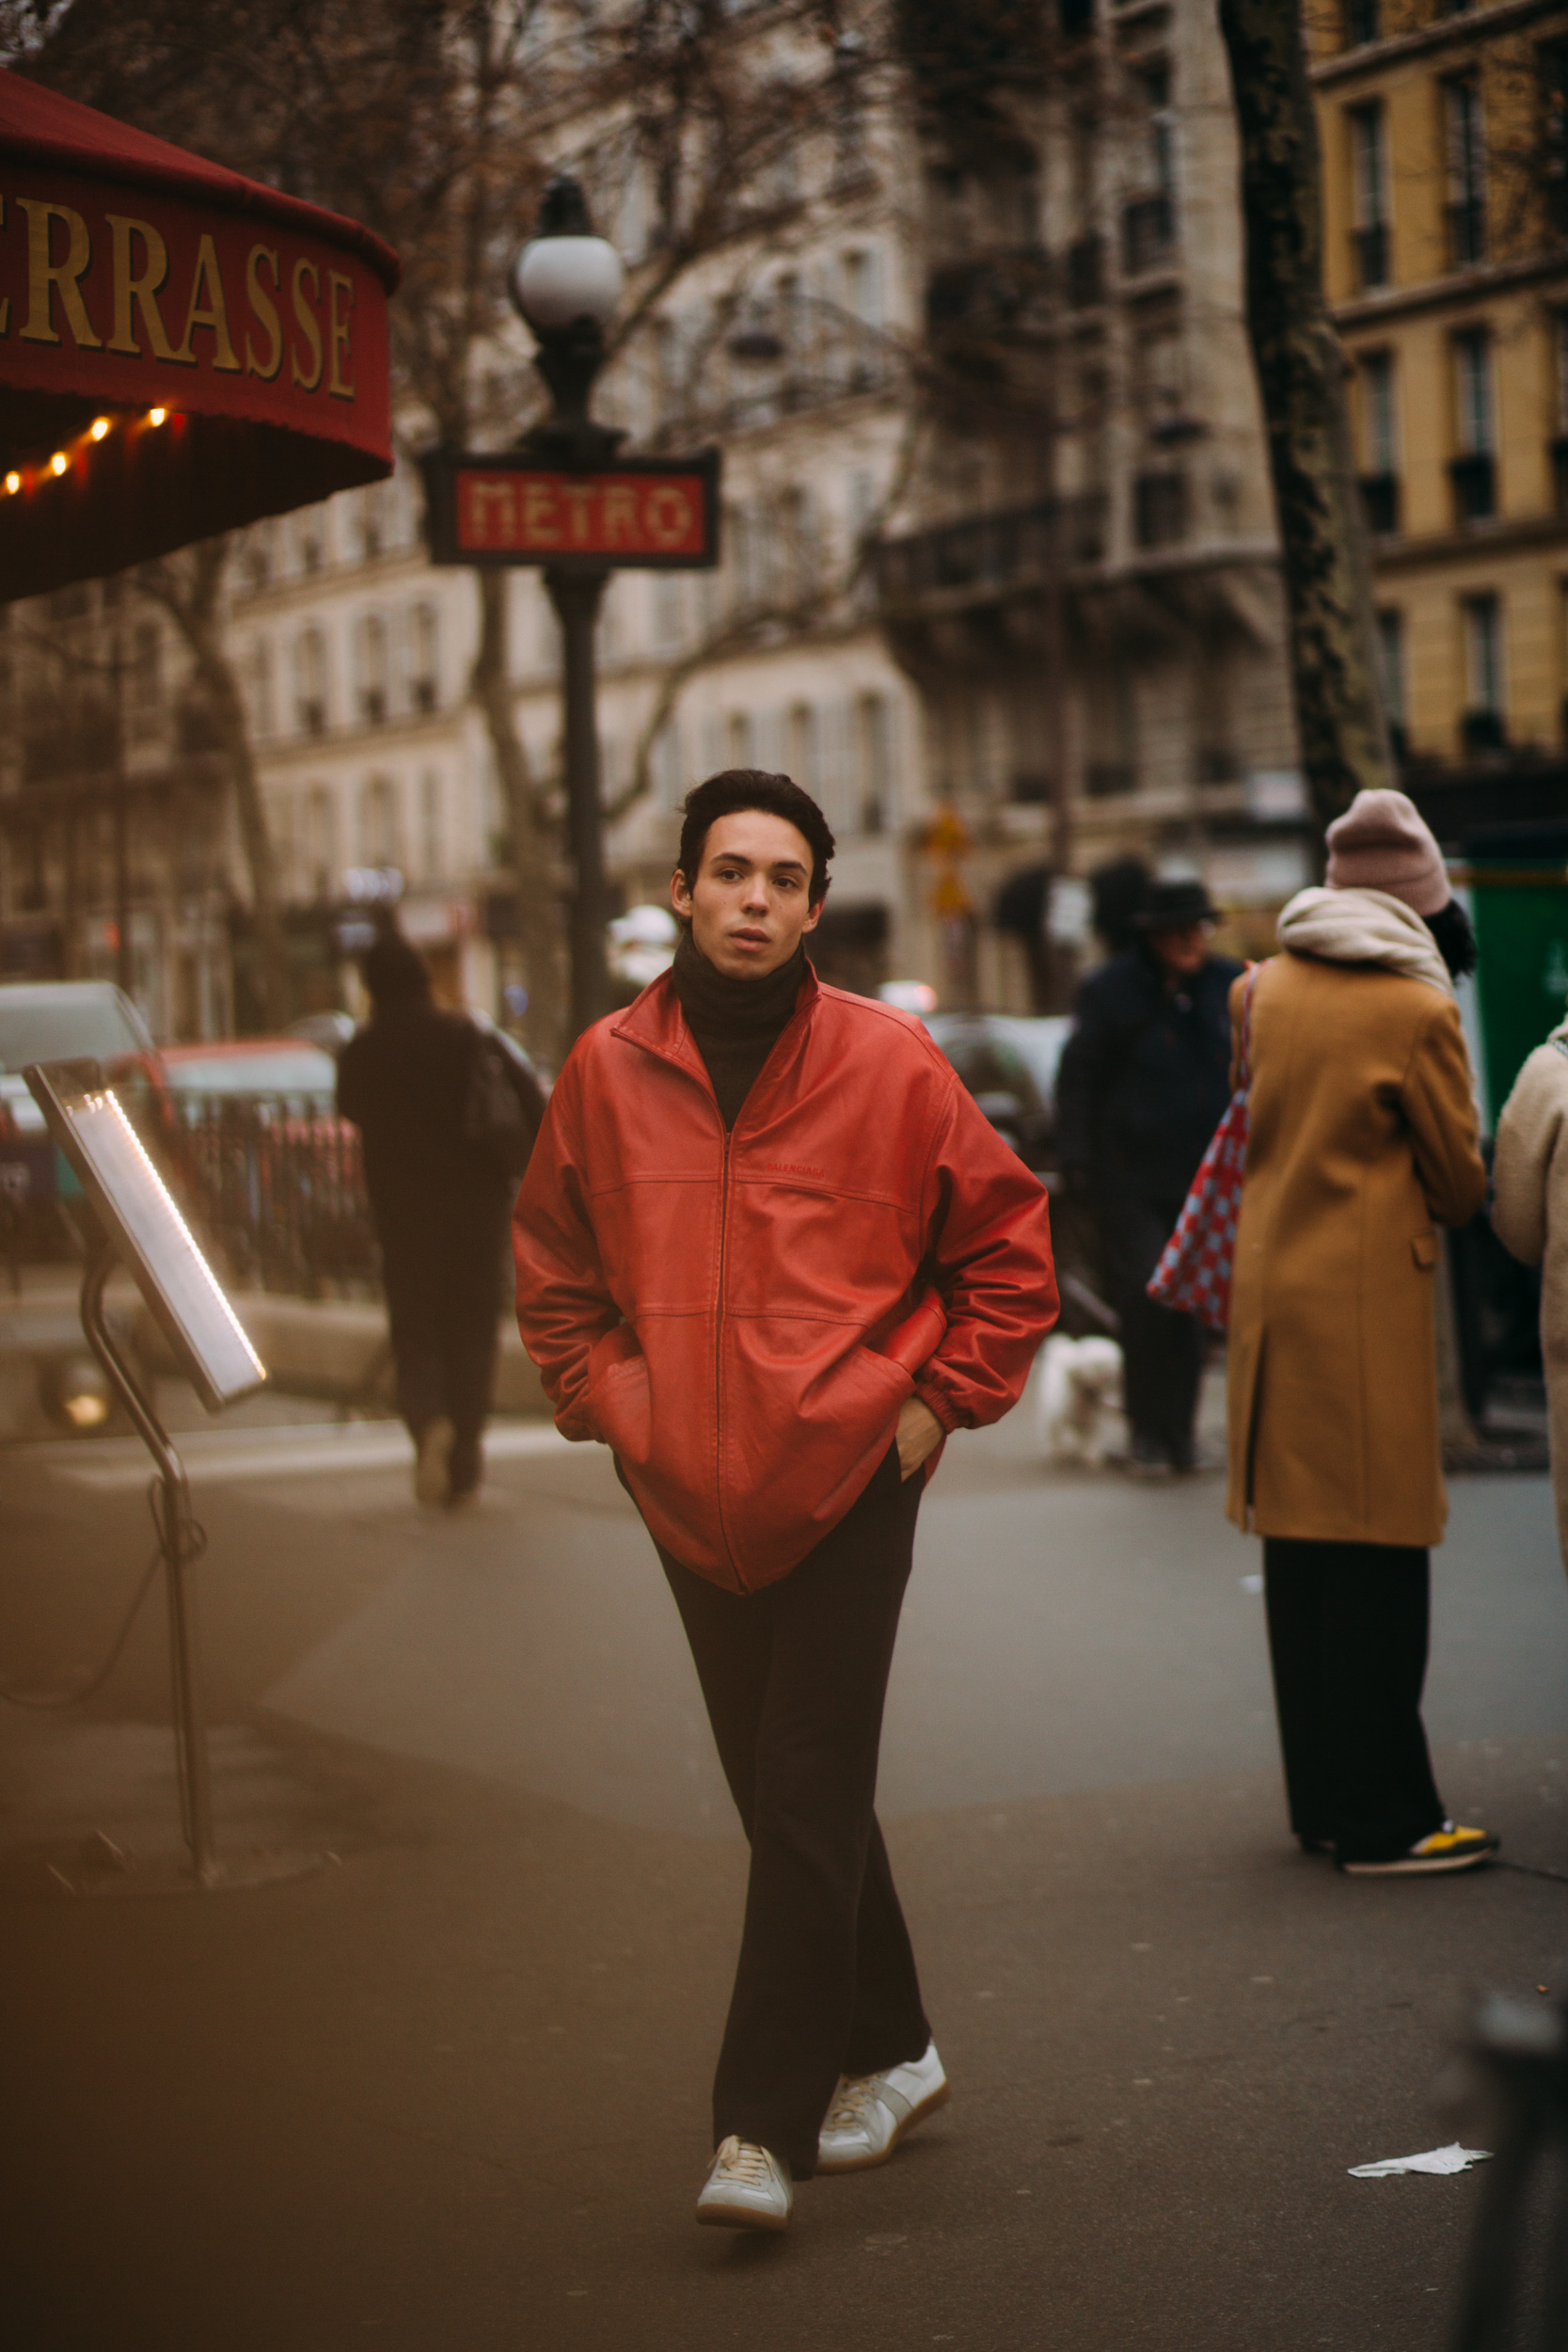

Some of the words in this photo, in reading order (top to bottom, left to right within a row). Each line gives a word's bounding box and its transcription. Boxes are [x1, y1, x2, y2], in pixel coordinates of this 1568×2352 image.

[0, 193, 356, 400] RRASSE
[471, 481, 692, 547] METRO
[767, 1163, 825, 1177] BALENCIAGA
